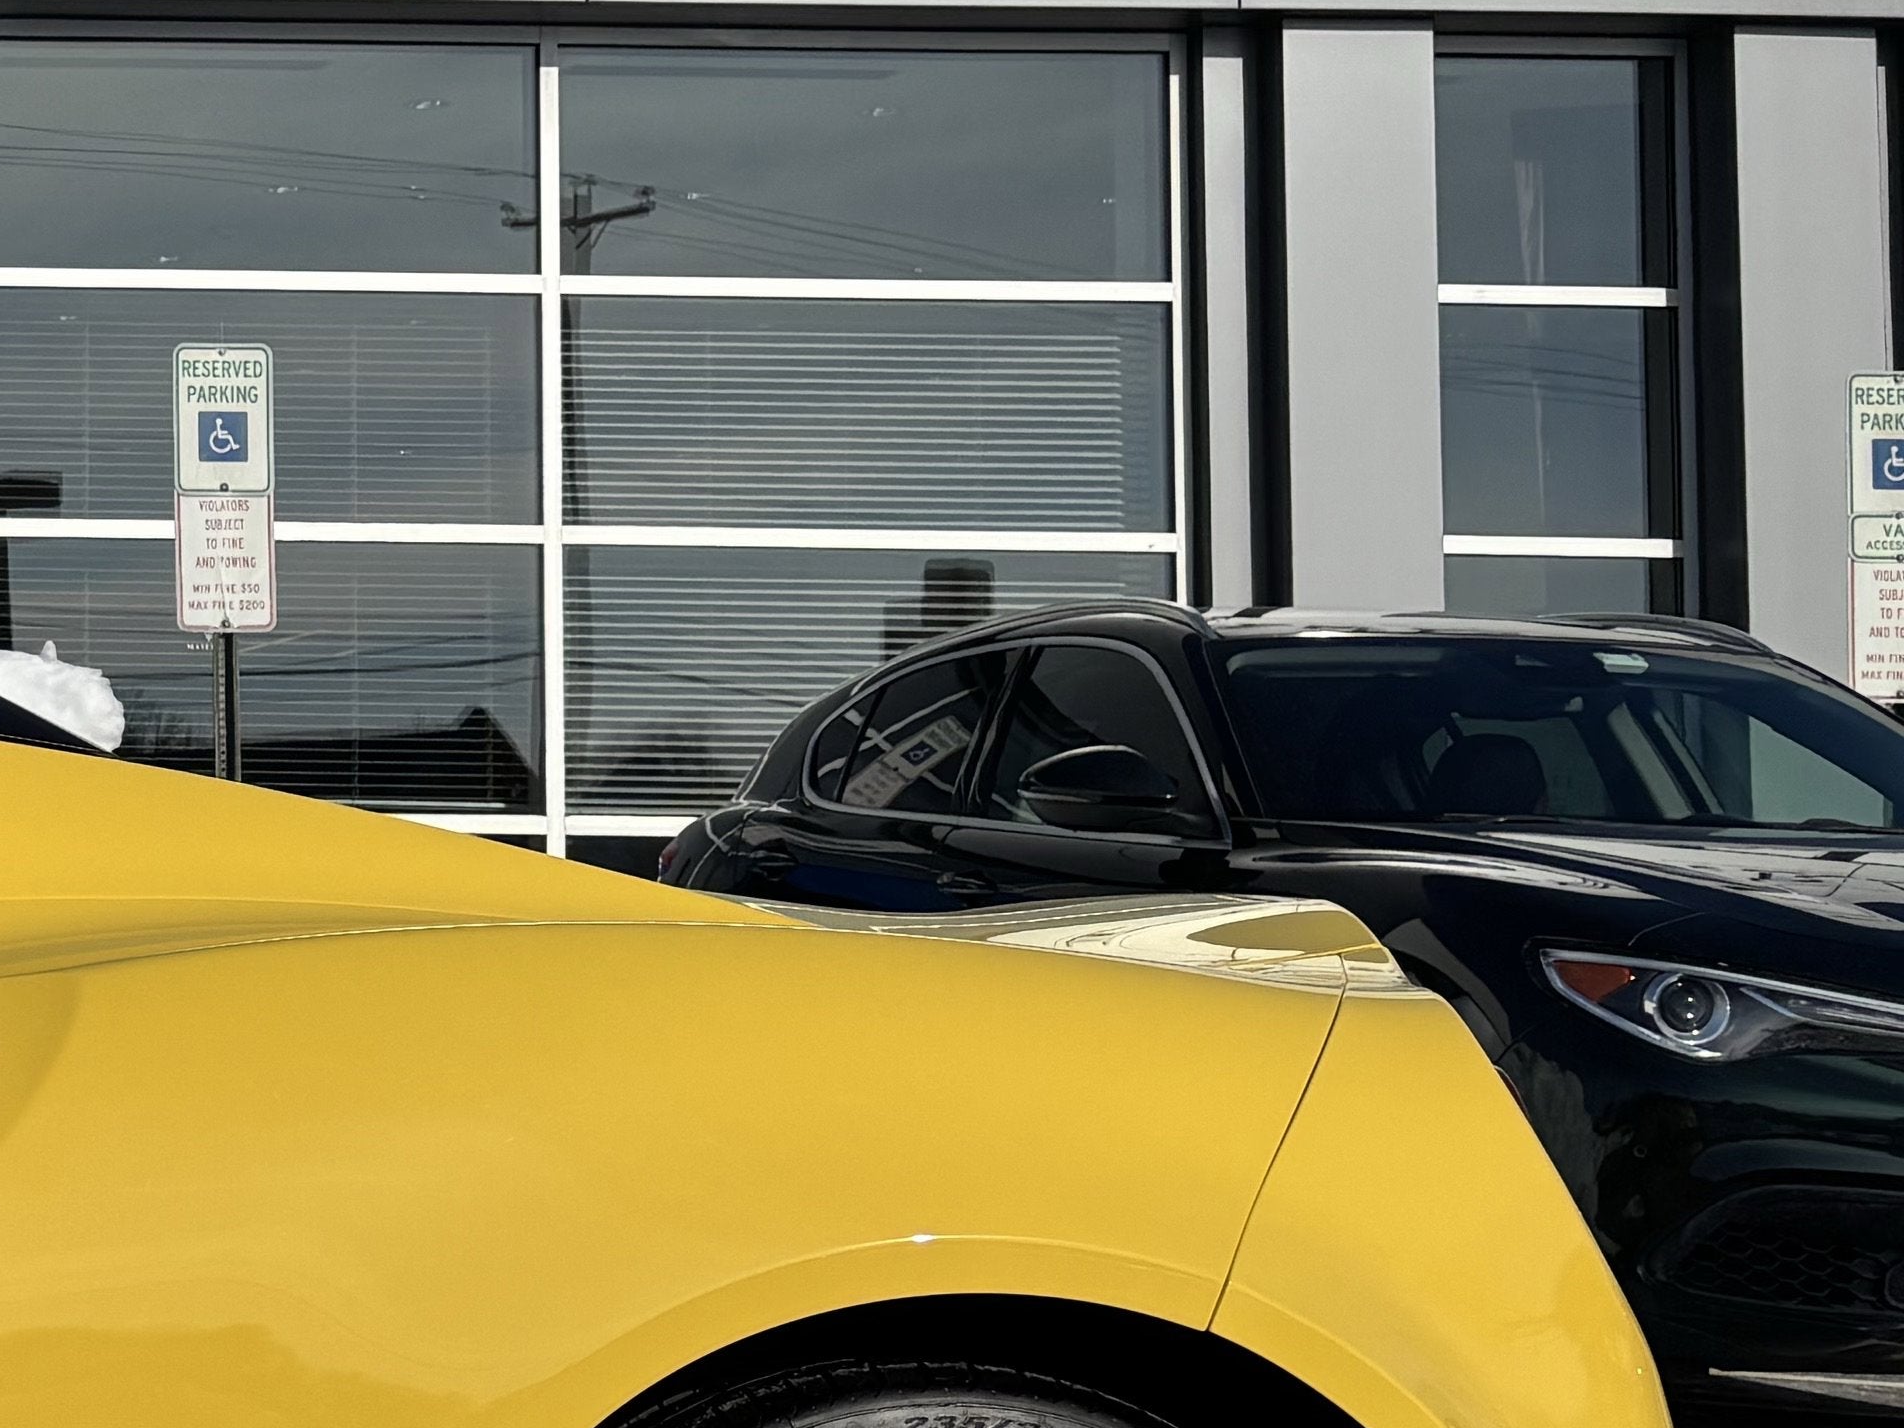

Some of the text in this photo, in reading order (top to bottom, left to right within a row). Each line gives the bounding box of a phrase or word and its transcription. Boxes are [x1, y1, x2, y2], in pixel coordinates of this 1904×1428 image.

[182, 359, 263, 378] RESERVED
[187, 385, 258, 404] PARKING
[1860, 413, 1904, 430] PARK
[198, 500, 250, 512] VIOLATORS
[205, 518, 244, 531] SUBJECT
[206, 538, 244, 549] TO FINE
[195, 557, 215, 568] AND
[242, 584, 260, 594] $50
[239, 600, 265, 610] $200
[1880, 607, 1893, 619] TO
[1869, 626, 1890, 638] AND
[1866, 654, 1885, 663] MIN
[1861, 671, 1882, 679] MAX
